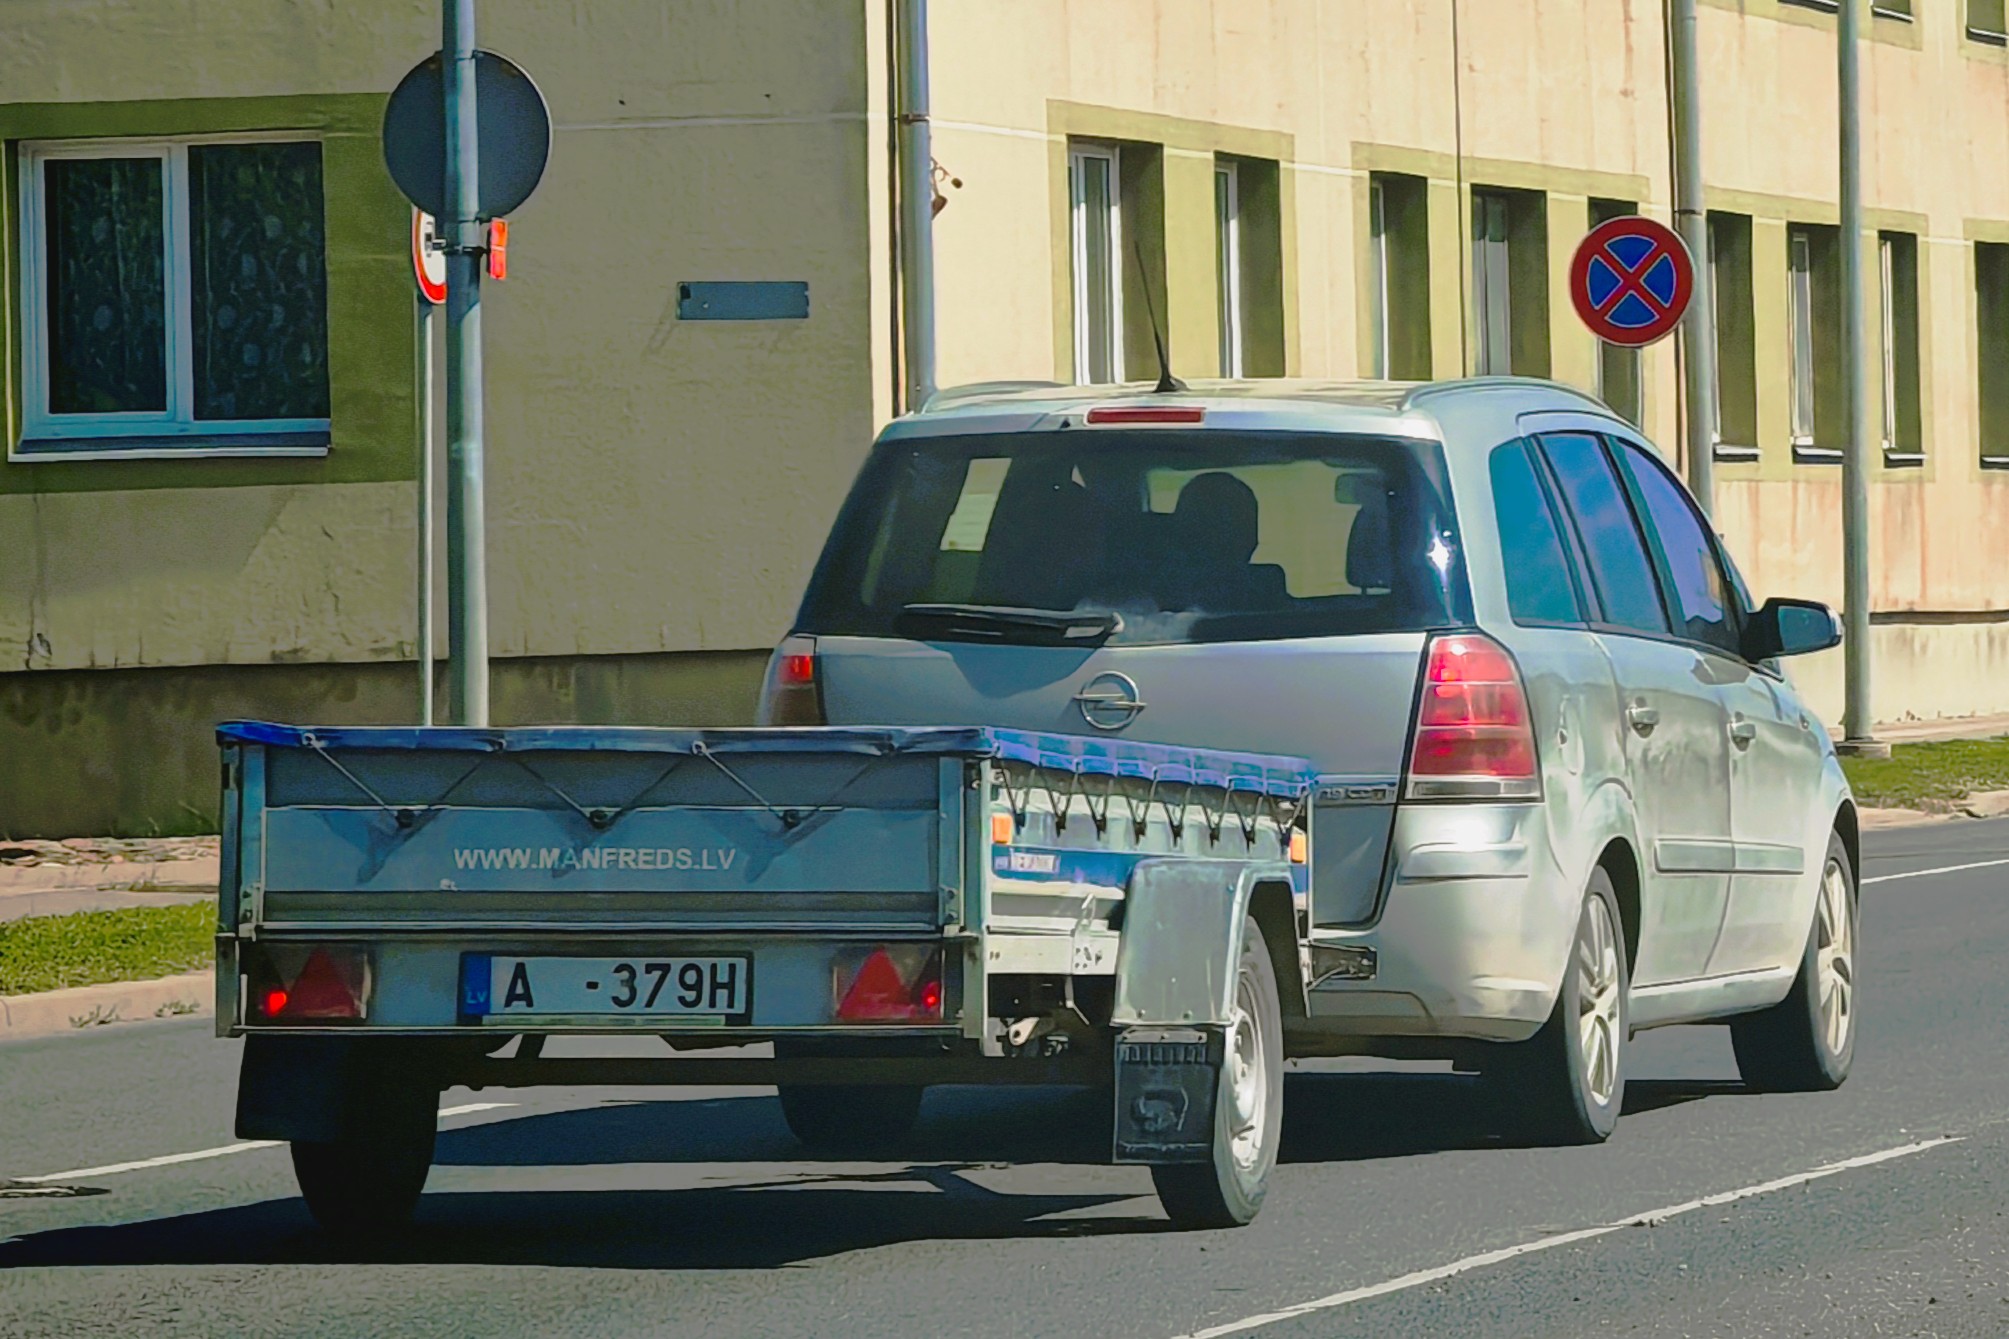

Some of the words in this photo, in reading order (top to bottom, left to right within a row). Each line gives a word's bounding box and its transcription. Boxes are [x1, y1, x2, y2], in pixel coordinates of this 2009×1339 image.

[454, 847, 736, 871] WWW.MANFREDS.LV
[465, 990, 486, 1004] LV
[503, 961, 534, 1009] A
